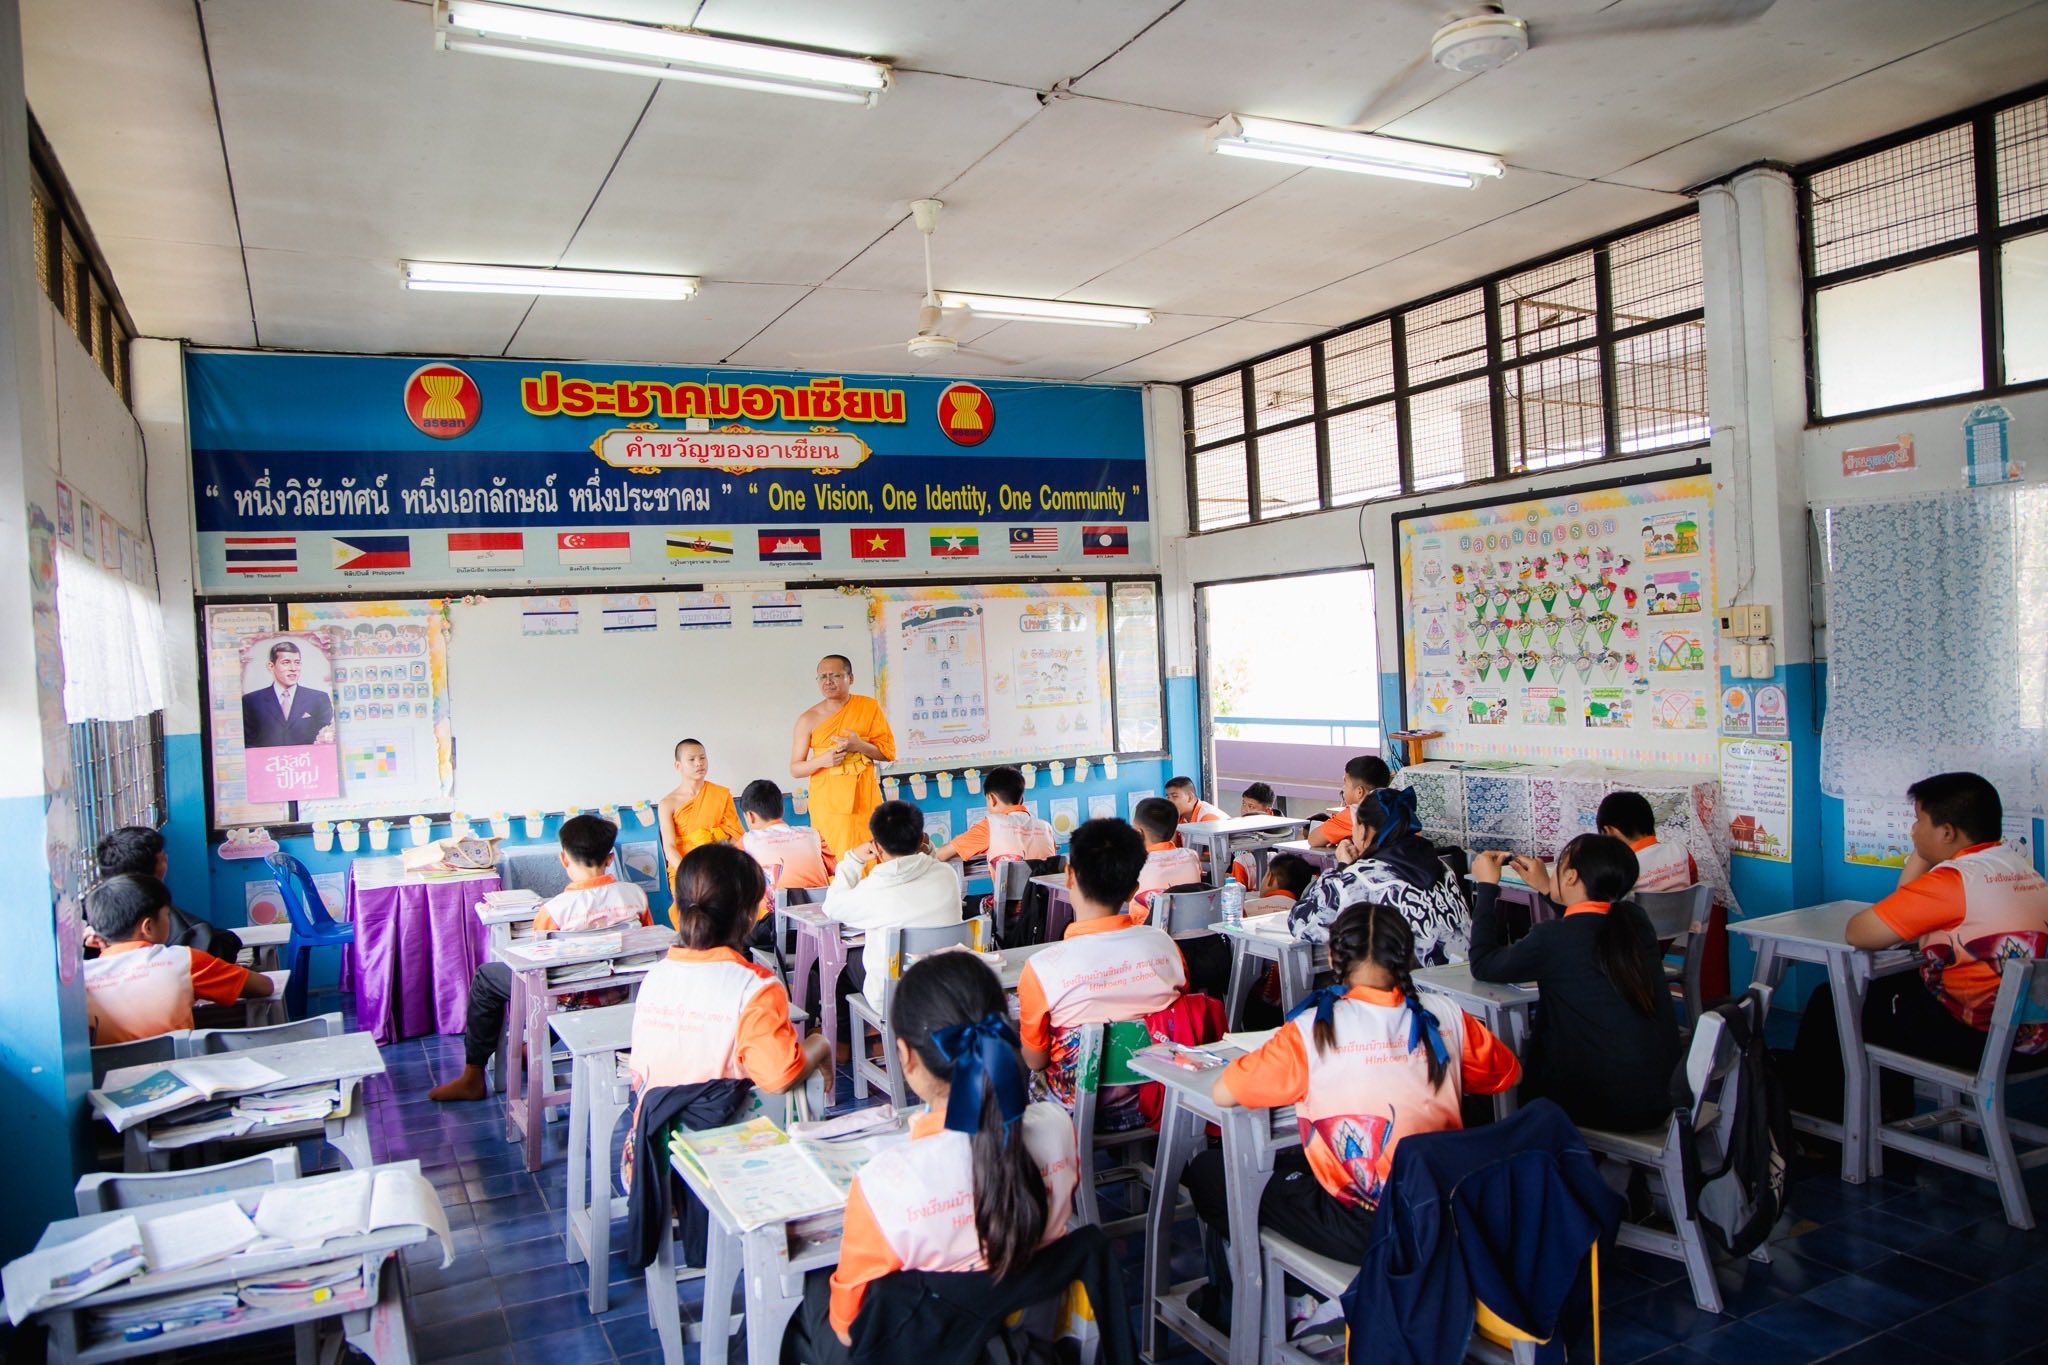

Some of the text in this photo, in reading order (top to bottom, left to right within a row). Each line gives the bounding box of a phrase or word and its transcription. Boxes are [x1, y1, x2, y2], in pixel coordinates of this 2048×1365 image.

[522, 371, 907, 423] ประชาคมอาเซียน
[423, 418, 466, 429] asean
[626, 435, 840, 464] คำขวัญของอาเซียน
[234, 469, 390, 516] หนึ่งวิสัยทัศน์
[401, 469, 558, 514] หนึ่งเอกลักษณ์
[569, 469, 711, 513] หนึ่งประชาคม
[768, 483, 806, 511] One
[814, 483, 874, 514] Vision,
[882, 484, 917, 511] One
[926, 484, 991, 516] Identity,
[999, 484, 1032, 511] One
[1039, 484, 1126, 515] Community
[265, 752, 311, 772] สวัสดี
